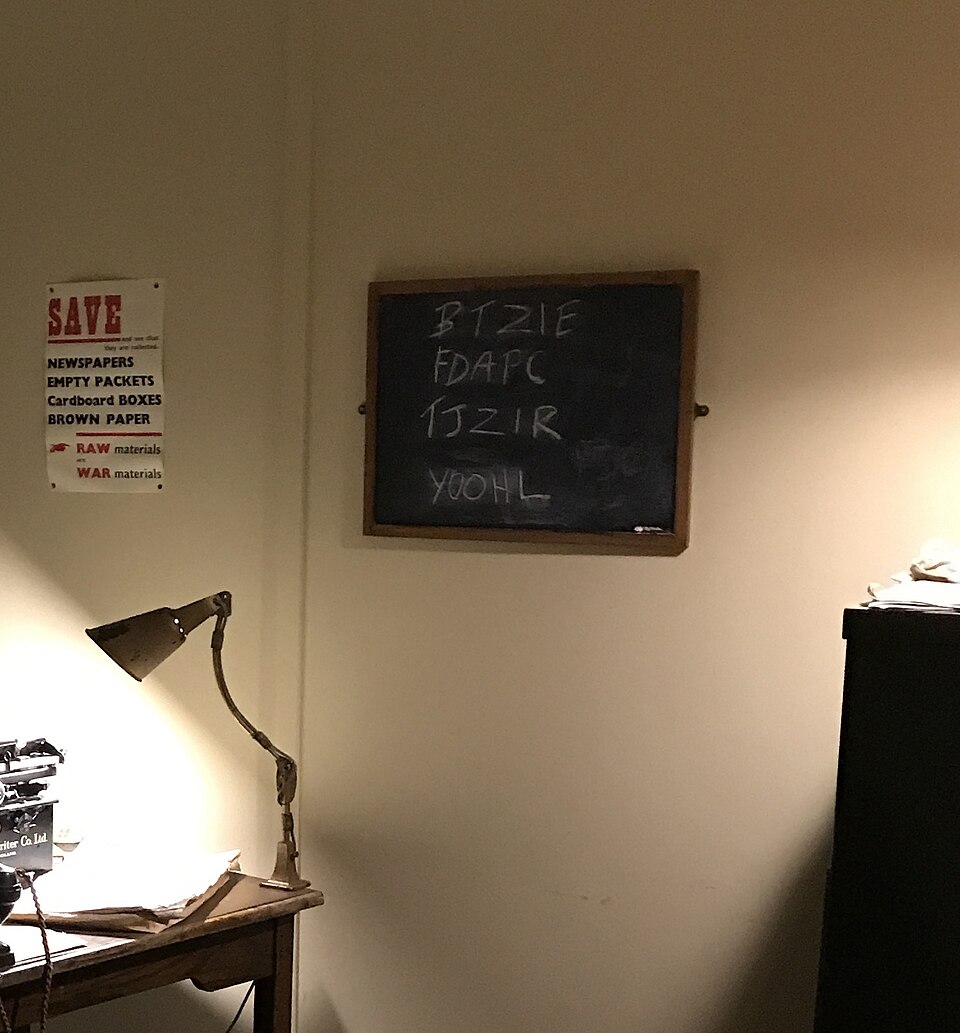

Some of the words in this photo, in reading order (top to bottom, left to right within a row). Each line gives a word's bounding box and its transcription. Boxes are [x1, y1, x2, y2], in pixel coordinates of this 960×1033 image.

[48, 295, 122, 337] SAVE
[104, 344, 117, 352] they
[47, 356, 134, 369] NEWSPAPERS
[434, 345, 546, 386] FDAPC
[47, 375, 90, 388] EMPTY
[95, 375, 155, 387] PACKETS
[47, 394, 114, 407] Cardboard
[119, 394, 162, 406] BOXES
[48, 413, 100, 425] BROWN
[106, 413, 151, 425] PAPER
[76, 442, 111, 455] RAW
[114, 443, 161, 455] materials
[77, 467, 111, 479] WAR
[114, 468, 162, 479] materials
[20, 835, 33, 847] Co.
